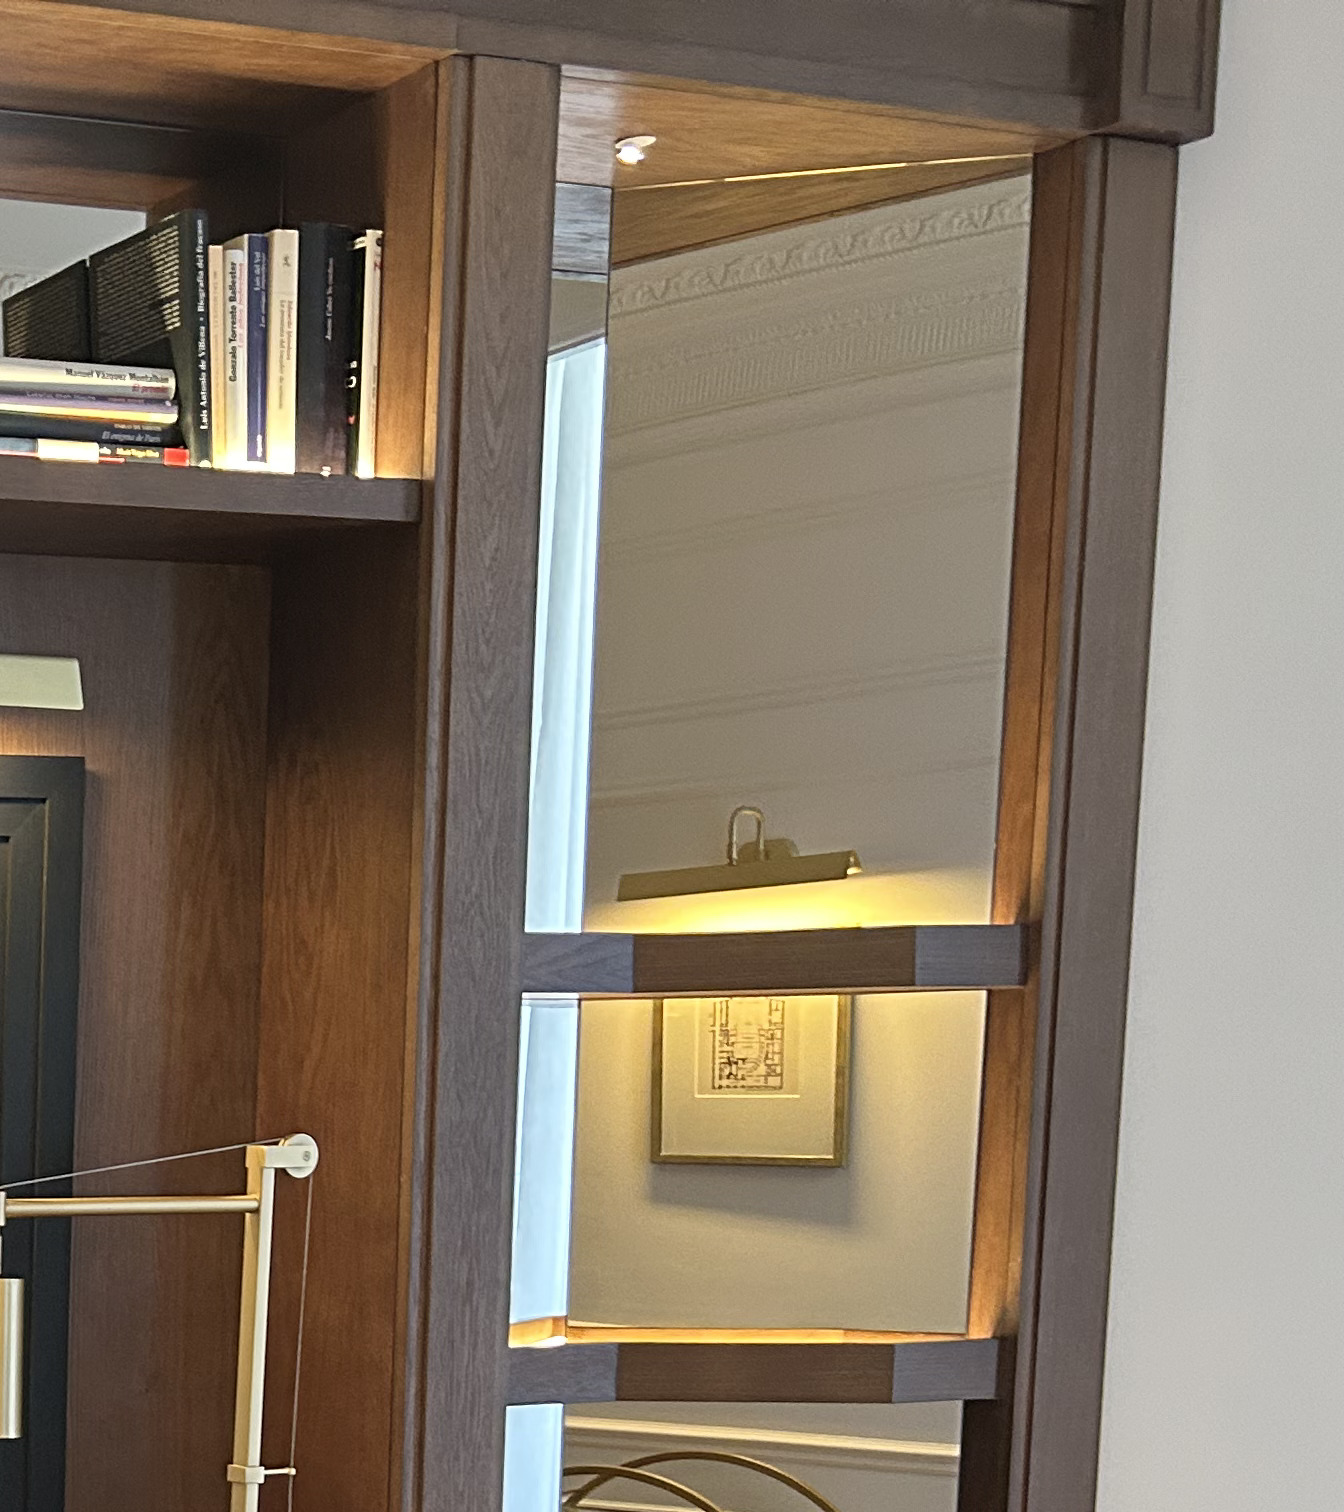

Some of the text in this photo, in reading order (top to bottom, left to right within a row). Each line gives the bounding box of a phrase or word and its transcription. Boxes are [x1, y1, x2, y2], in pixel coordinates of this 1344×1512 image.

[228, 262, 238, 382] Gonzalo Torrente Ballester
[198, 326, 206, 357] Villena
[198, 359, 207, 371] de
[199, 372, 208, 407] Antonio
[200, 409, 208, 430] Luis
